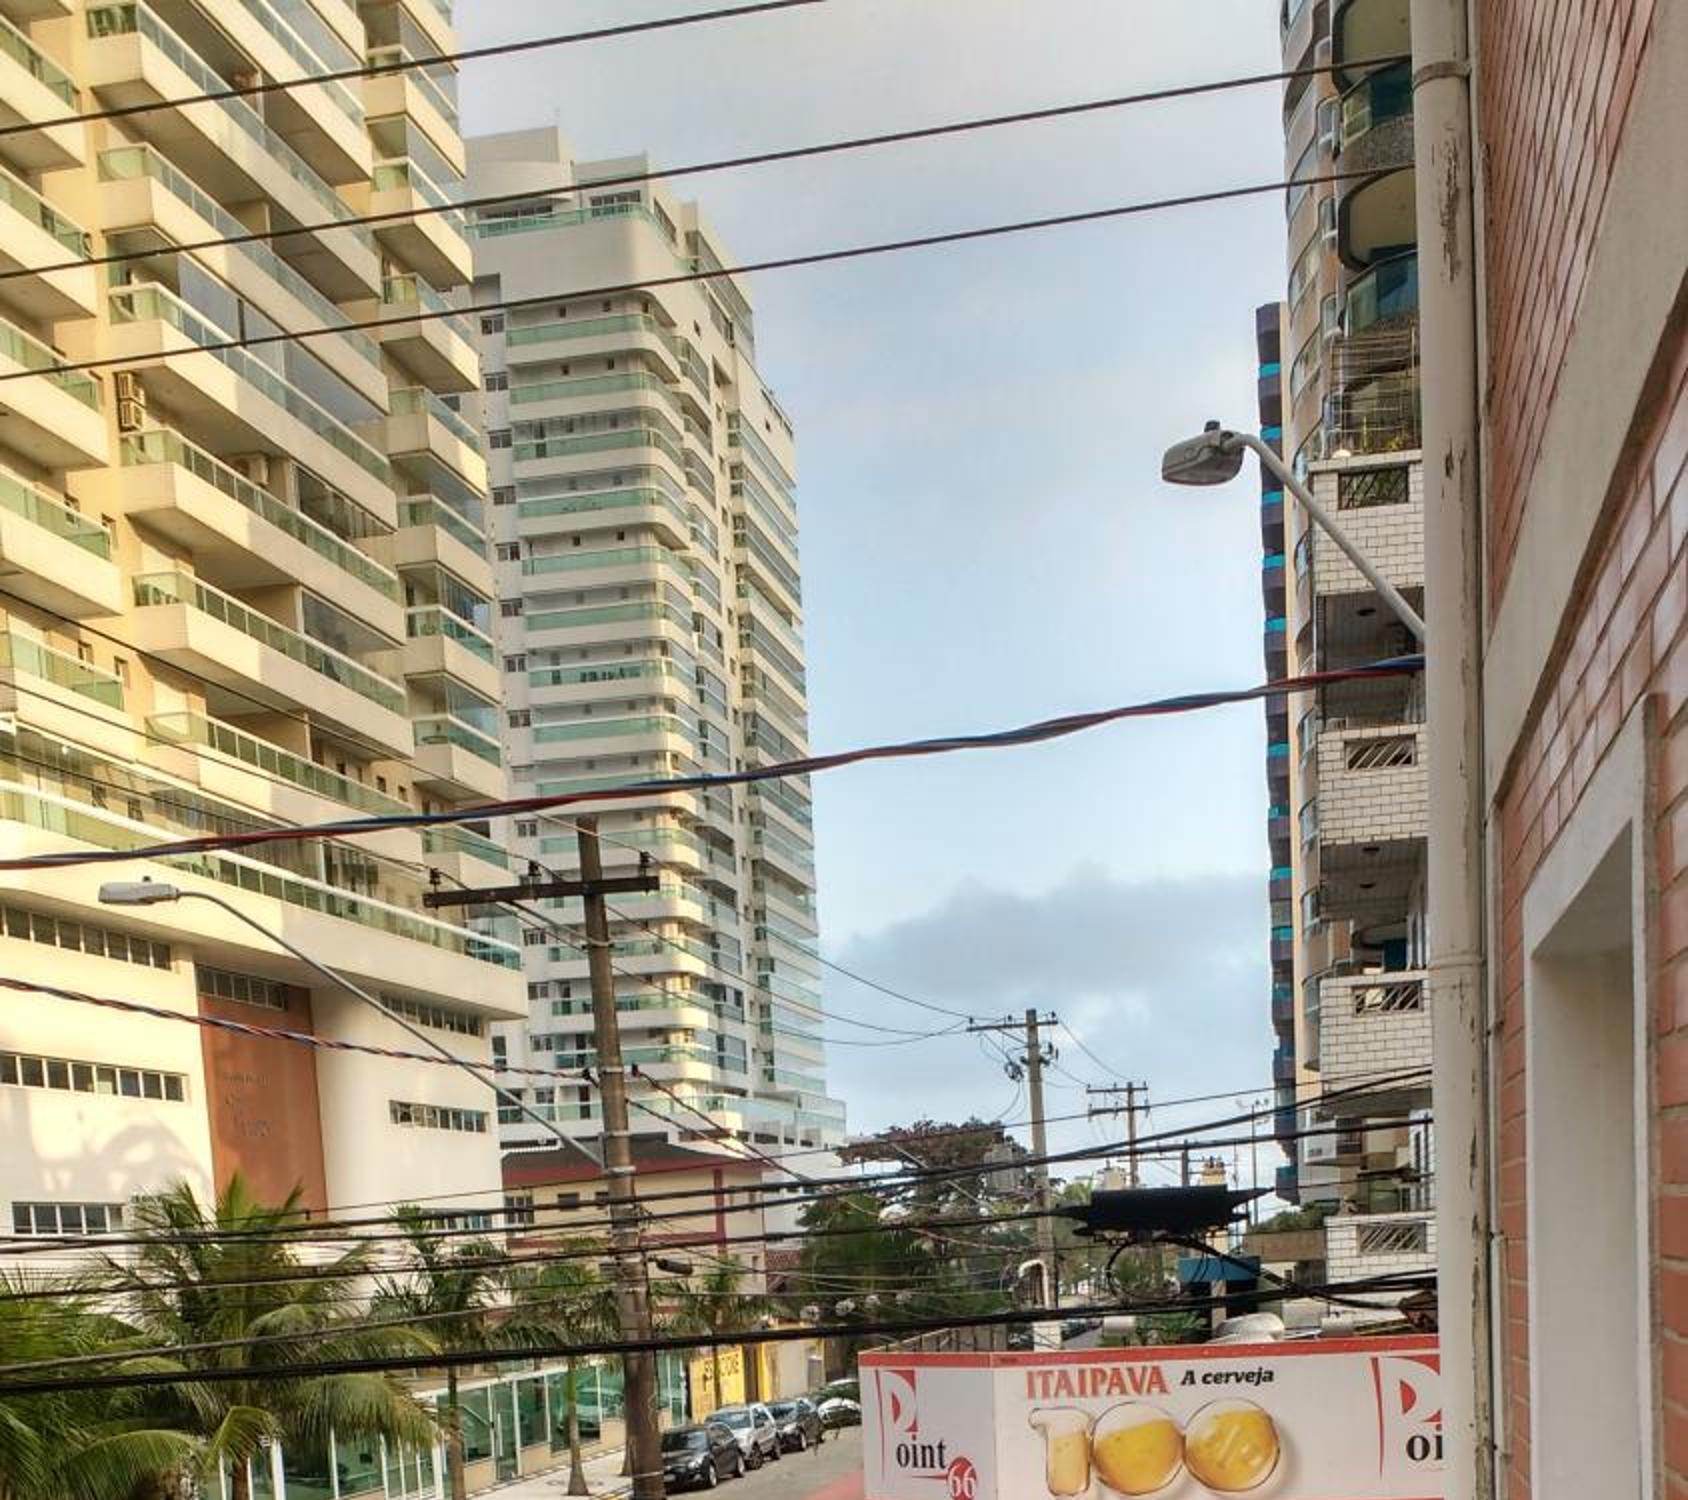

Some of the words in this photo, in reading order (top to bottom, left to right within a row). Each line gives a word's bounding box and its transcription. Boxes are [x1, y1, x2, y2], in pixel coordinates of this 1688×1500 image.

[1026, 1366, 1170, 1400] ITAIPAVA
[1180, 1370, 1197, 1387] A
[1202, 1367, 1275, 1388] cerveja
[948, 1461, 976, 1499] 66
